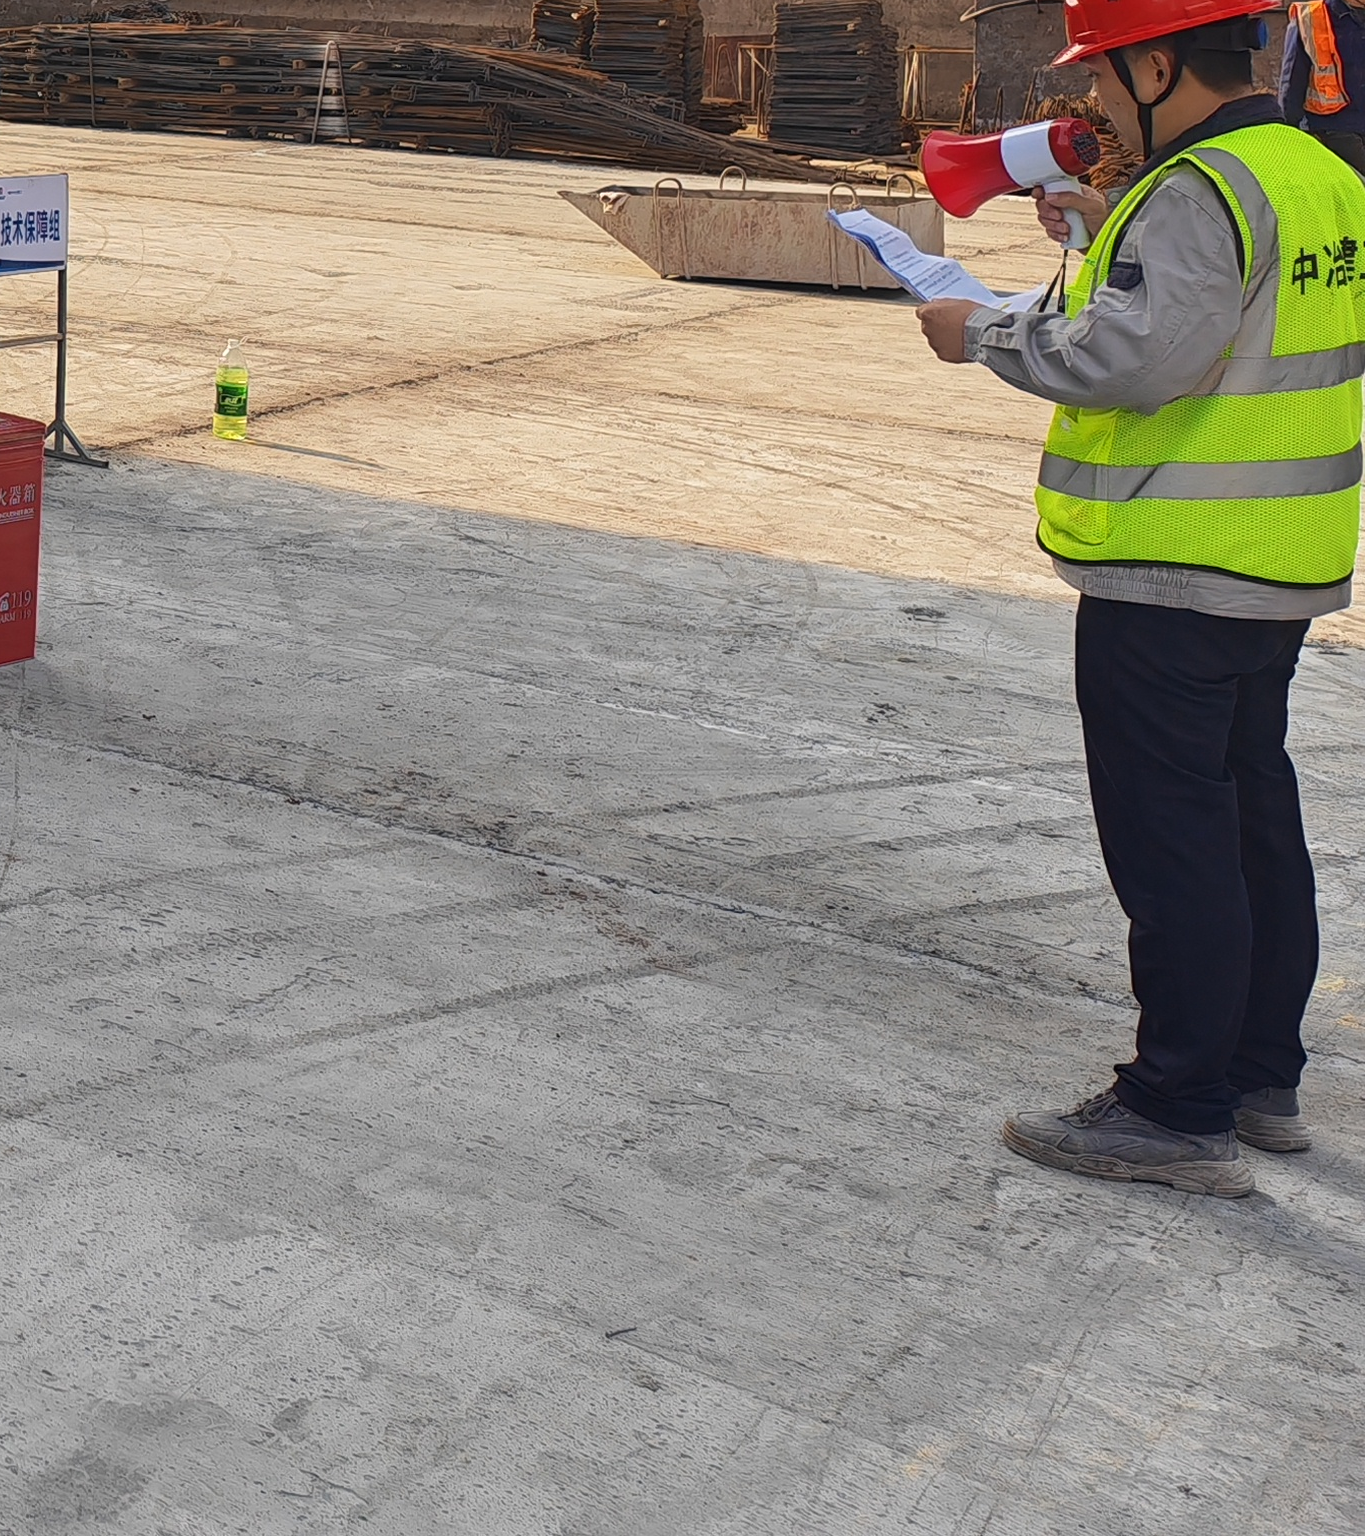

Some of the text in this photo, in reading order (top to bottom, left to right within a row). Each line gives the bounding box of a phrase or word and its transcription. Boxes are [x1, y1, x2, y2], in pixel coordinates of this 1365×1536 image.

[0, 208, 60, 247] 技术保障组
[11, 589, 32, 609] 119
